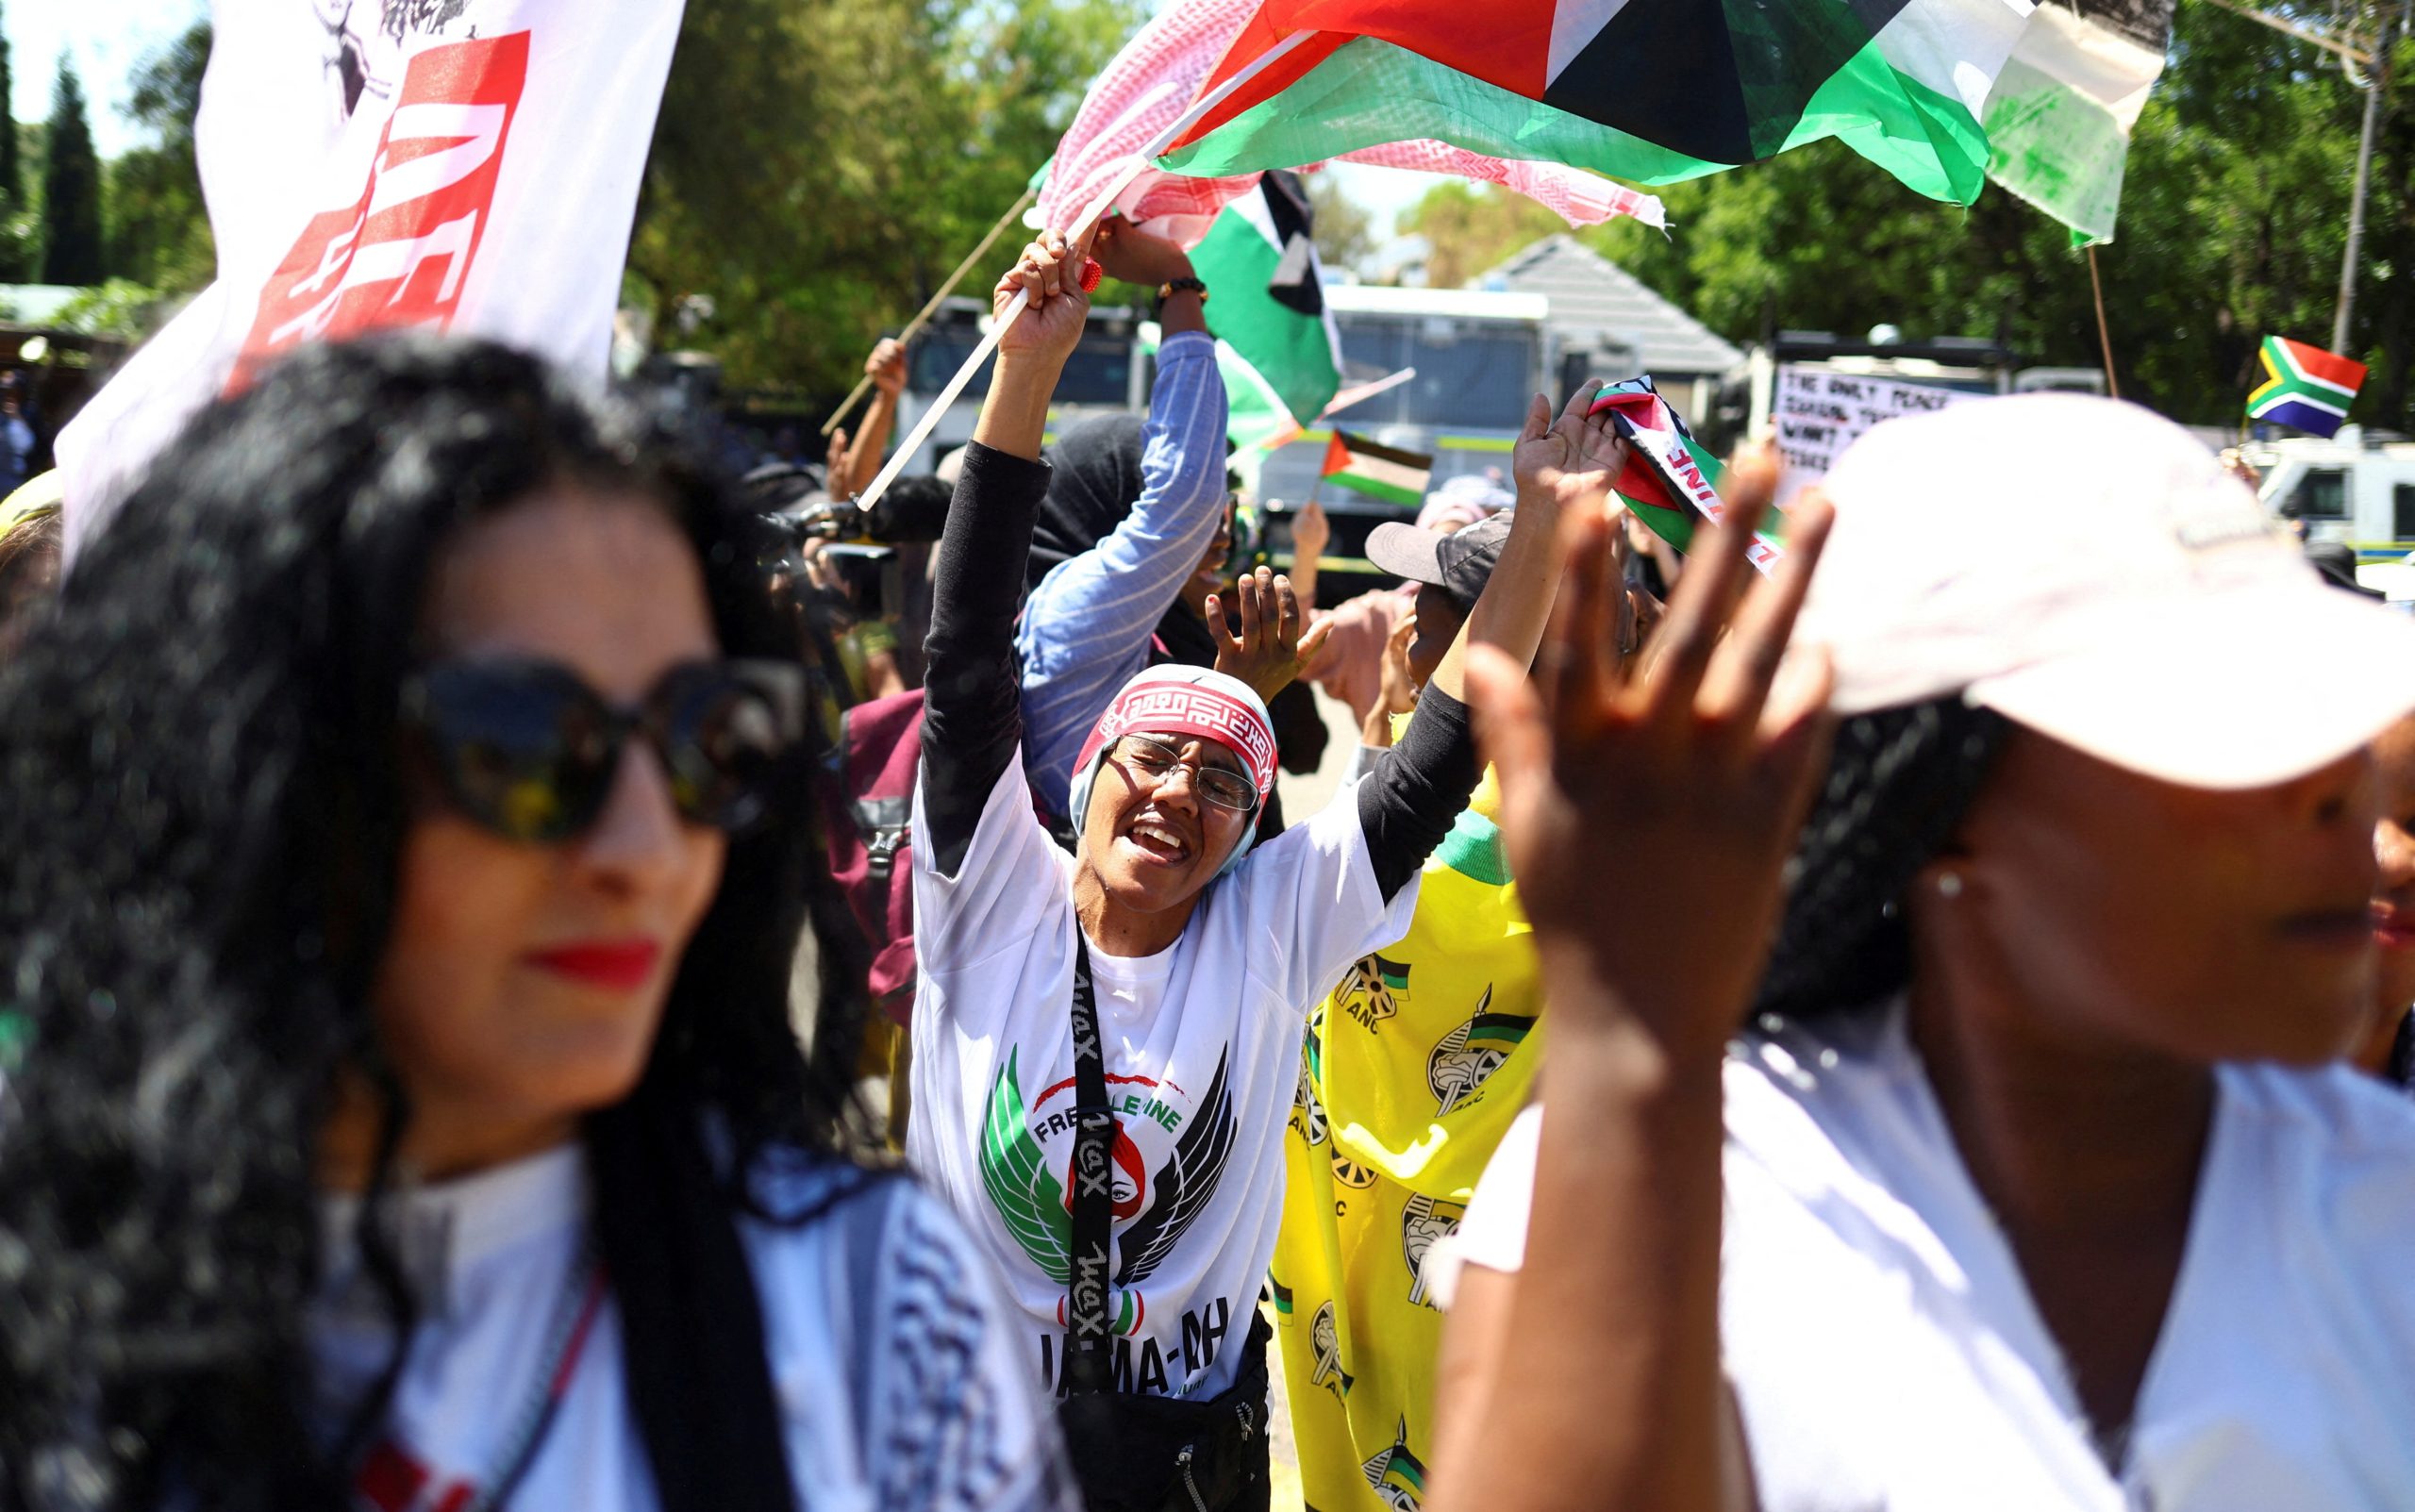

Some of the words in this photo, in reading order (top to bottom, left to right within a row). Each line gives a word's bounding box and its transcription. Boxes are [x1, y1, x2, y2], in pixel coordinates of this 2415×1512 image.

[1827, 379, 1877, 401] ONLY
[1347, 1002, 1378, 1035] ANC
[1034, 1105, 1077, 1144] FRE
[1108, 1094, 1183, 1134] LEINE
